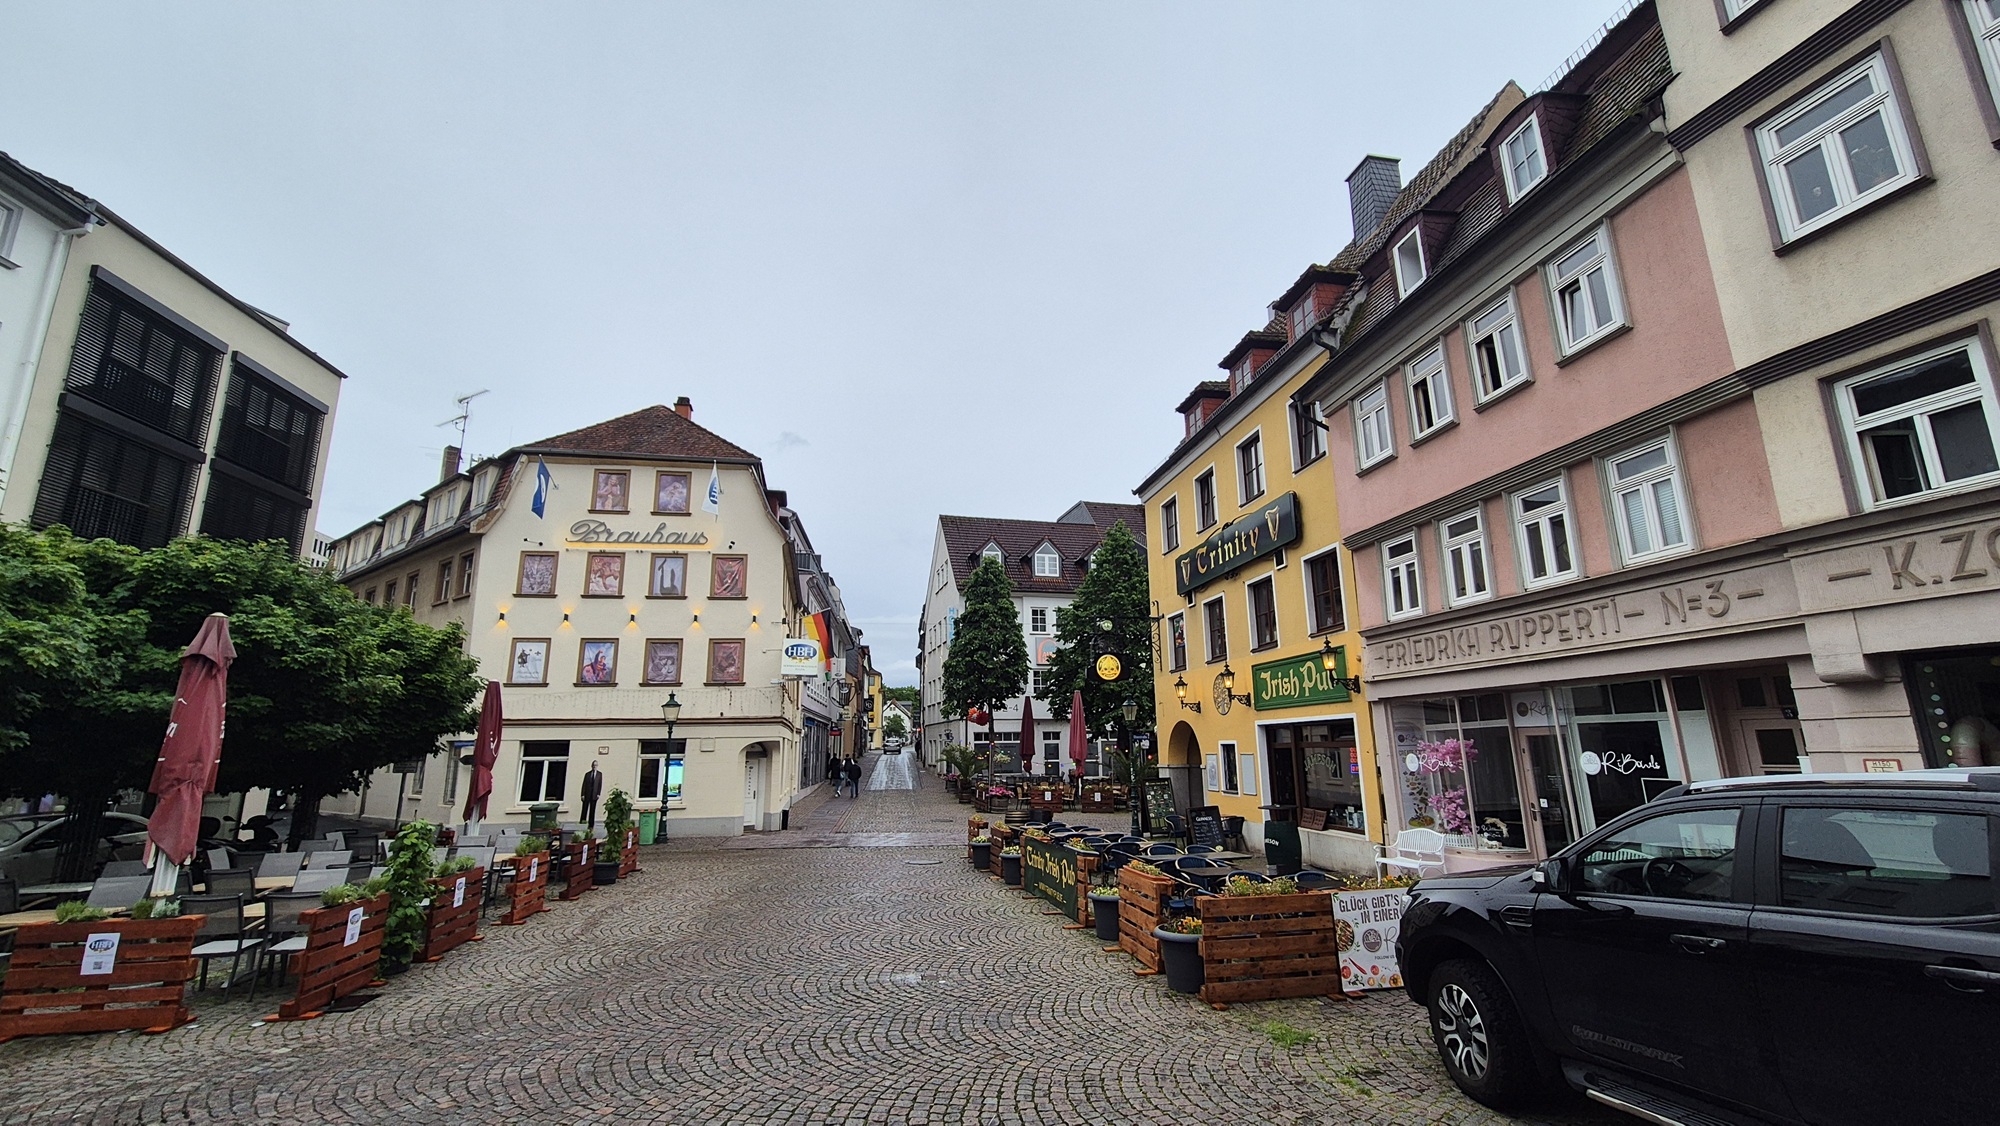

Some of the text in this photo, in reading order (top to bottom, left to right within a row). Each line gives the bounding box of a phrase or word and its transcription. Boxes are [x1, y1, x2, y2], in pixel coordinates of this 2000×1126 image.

[565, 519, 709, 545] Brauhaus
[1196, 526, 1259, 574] Trinity
[1384, 626, 1481, 669] FRIEDRICH
[1489, 595, 1621, 653] RUPPERTI
[788, 646, 814, 657] HBH
[1260, 669, 1300, 700] Irish
[1061, 859, 1076, 889] Pub
[1339, 894, 1400, 912] GLÜCK GIBT'S
[1361, 908, 1400, 923] IN EINER
